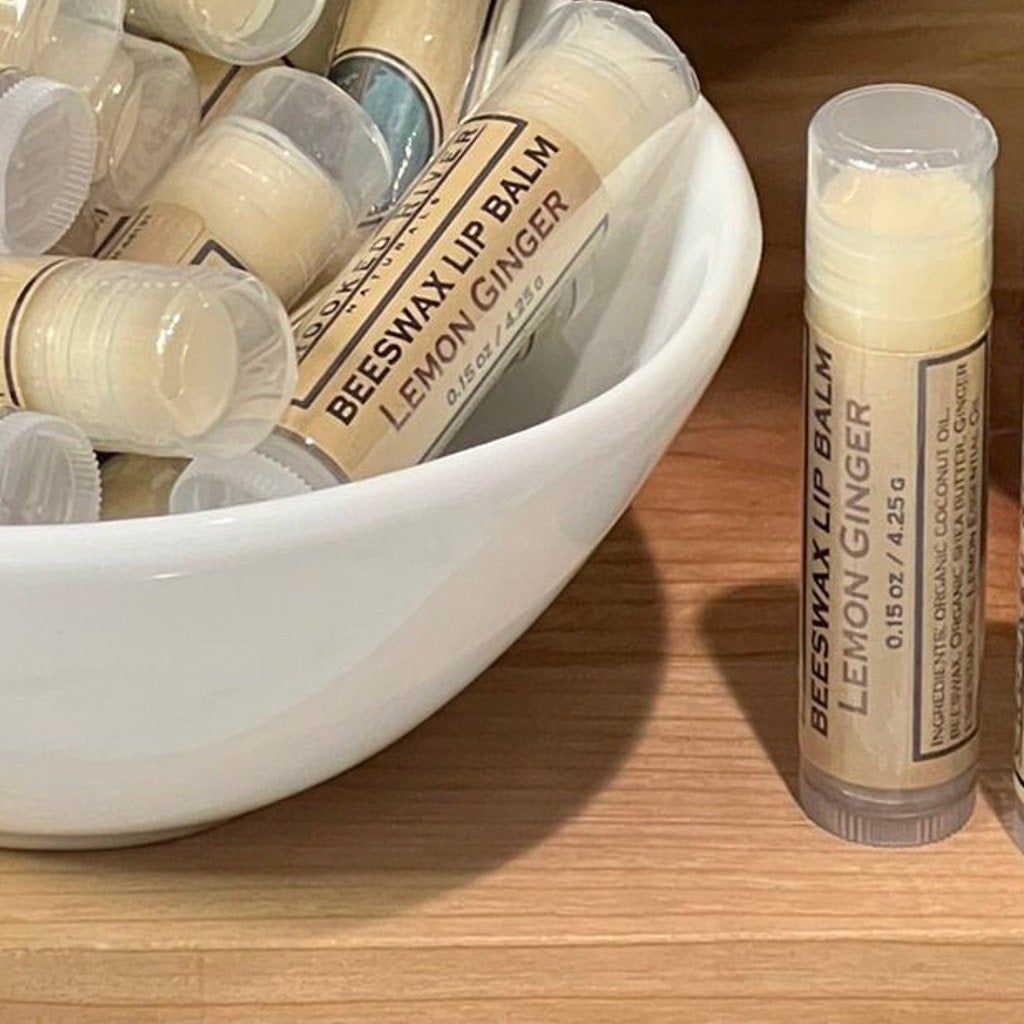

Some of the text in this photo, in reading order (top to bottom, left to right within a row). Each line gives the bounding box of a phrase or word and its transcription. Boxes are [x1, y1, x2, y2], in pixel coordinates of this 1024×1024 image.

[291, 230, 393, 356] OOKED
[324, 132, 560, 428] BEESWAX LIP BALM
[373, 187, 573, 432] LEMON GINGER
[441, 364, 479, 407] 0.15
[810, 344, 832, 736] BEESWAX LIP BALM
[886, 495, 904, 545] 4.25
[934, 448, 949, 536] COCONUT
[837, 398, 870, 716] LEMON GINGER
[932, 542, 946, 621] ORGANIC
[885, 600, 903, 649] 0.15
